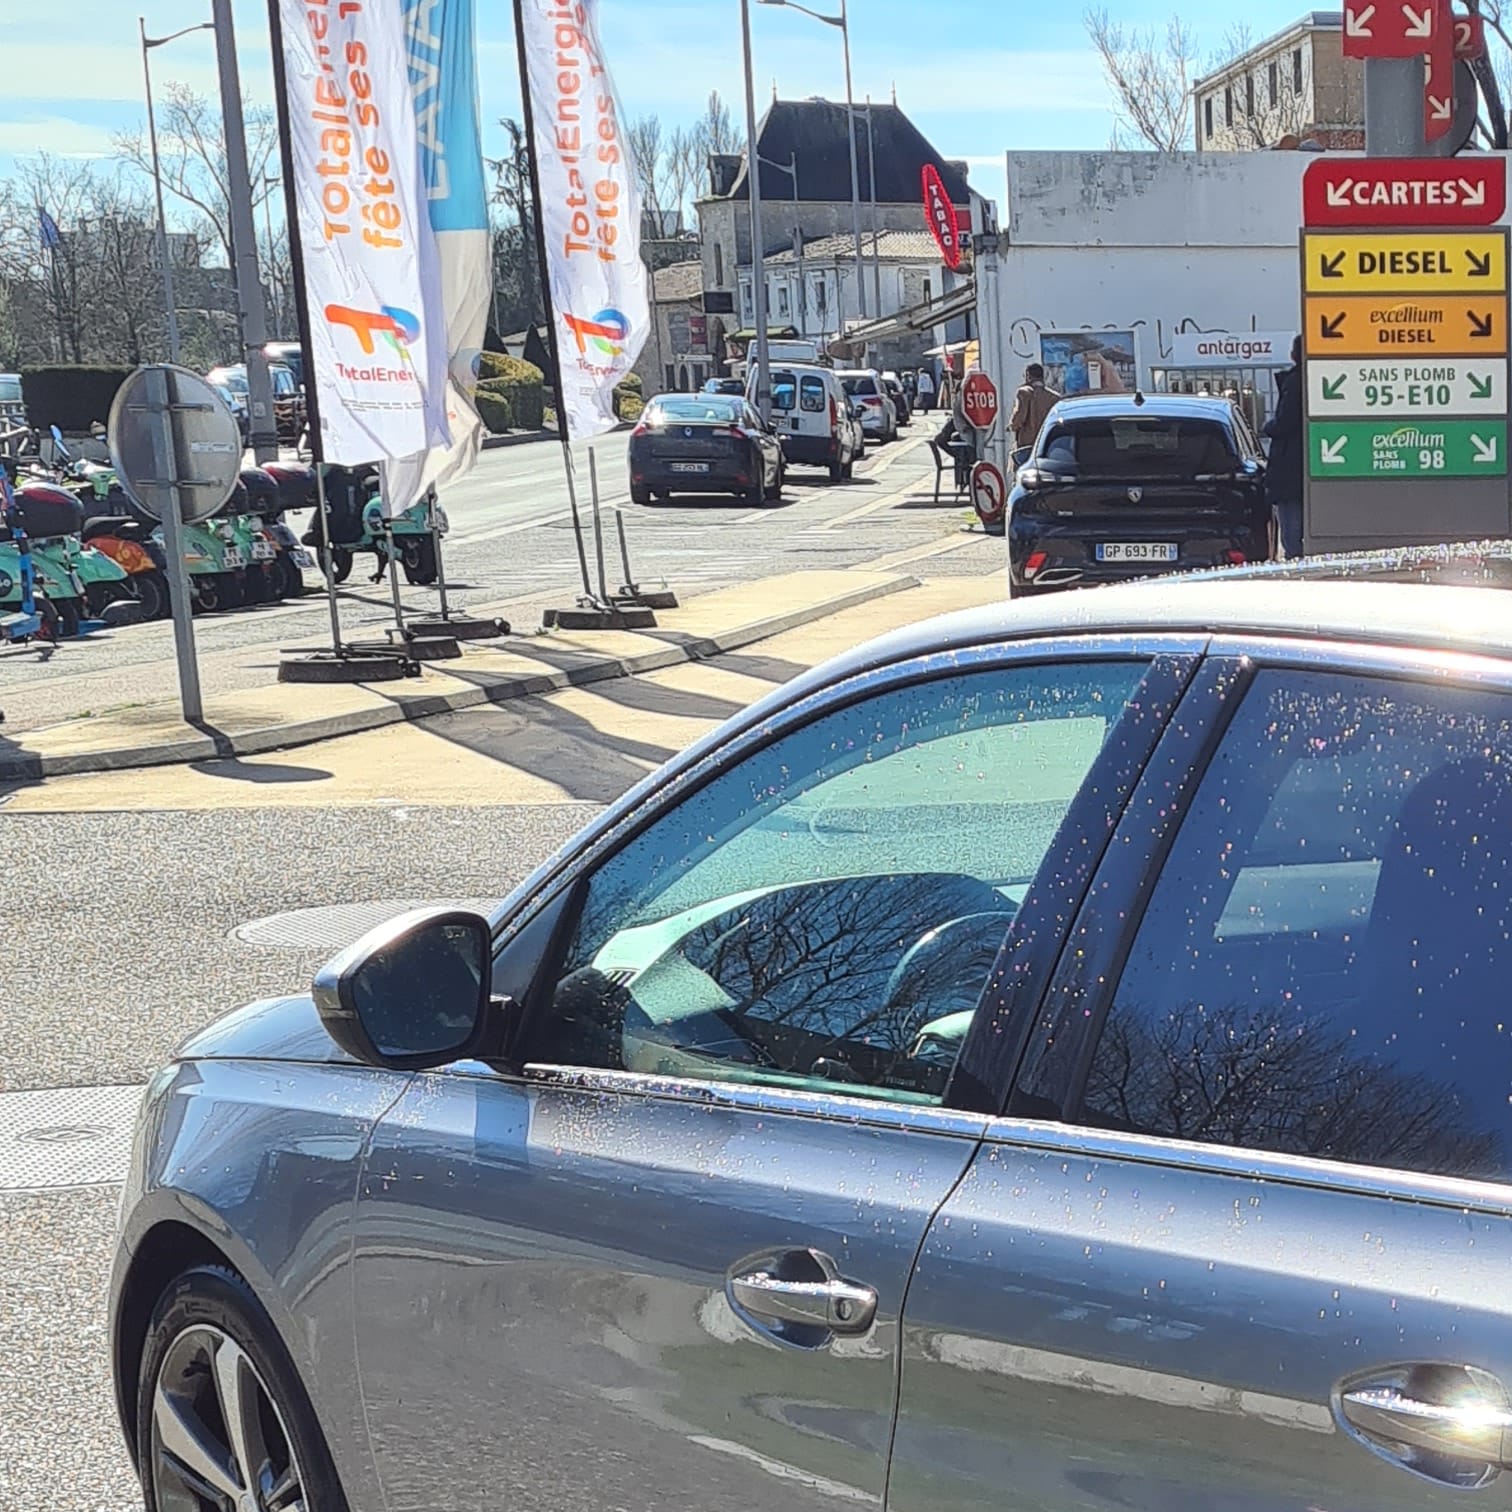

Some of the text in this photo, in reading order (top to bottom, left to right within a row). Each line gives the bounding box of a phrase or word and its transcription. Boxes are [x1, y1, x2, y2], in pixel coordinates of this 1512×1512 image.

[1454, 23, 1473, 51] 2
[346, 41, 379, 127] ses
[361, 146, 403, 248] fête
[1352, 180, 1458, 206] CARTES
[1358, 250, 1453, 275] DIESEL
[1369, 305, 1444, 325] excellium
[1378, 329, 1436, 344] DIESEL
[1197, 340, 1272, 360] antargaz
[1358, 367, 1456, 382] SANS PLOMB
[1364, 384, 1451, 407] 95-E10
[1372, 430, 1445, 448] excellium
[1418, 449, 1445, 470] 98
